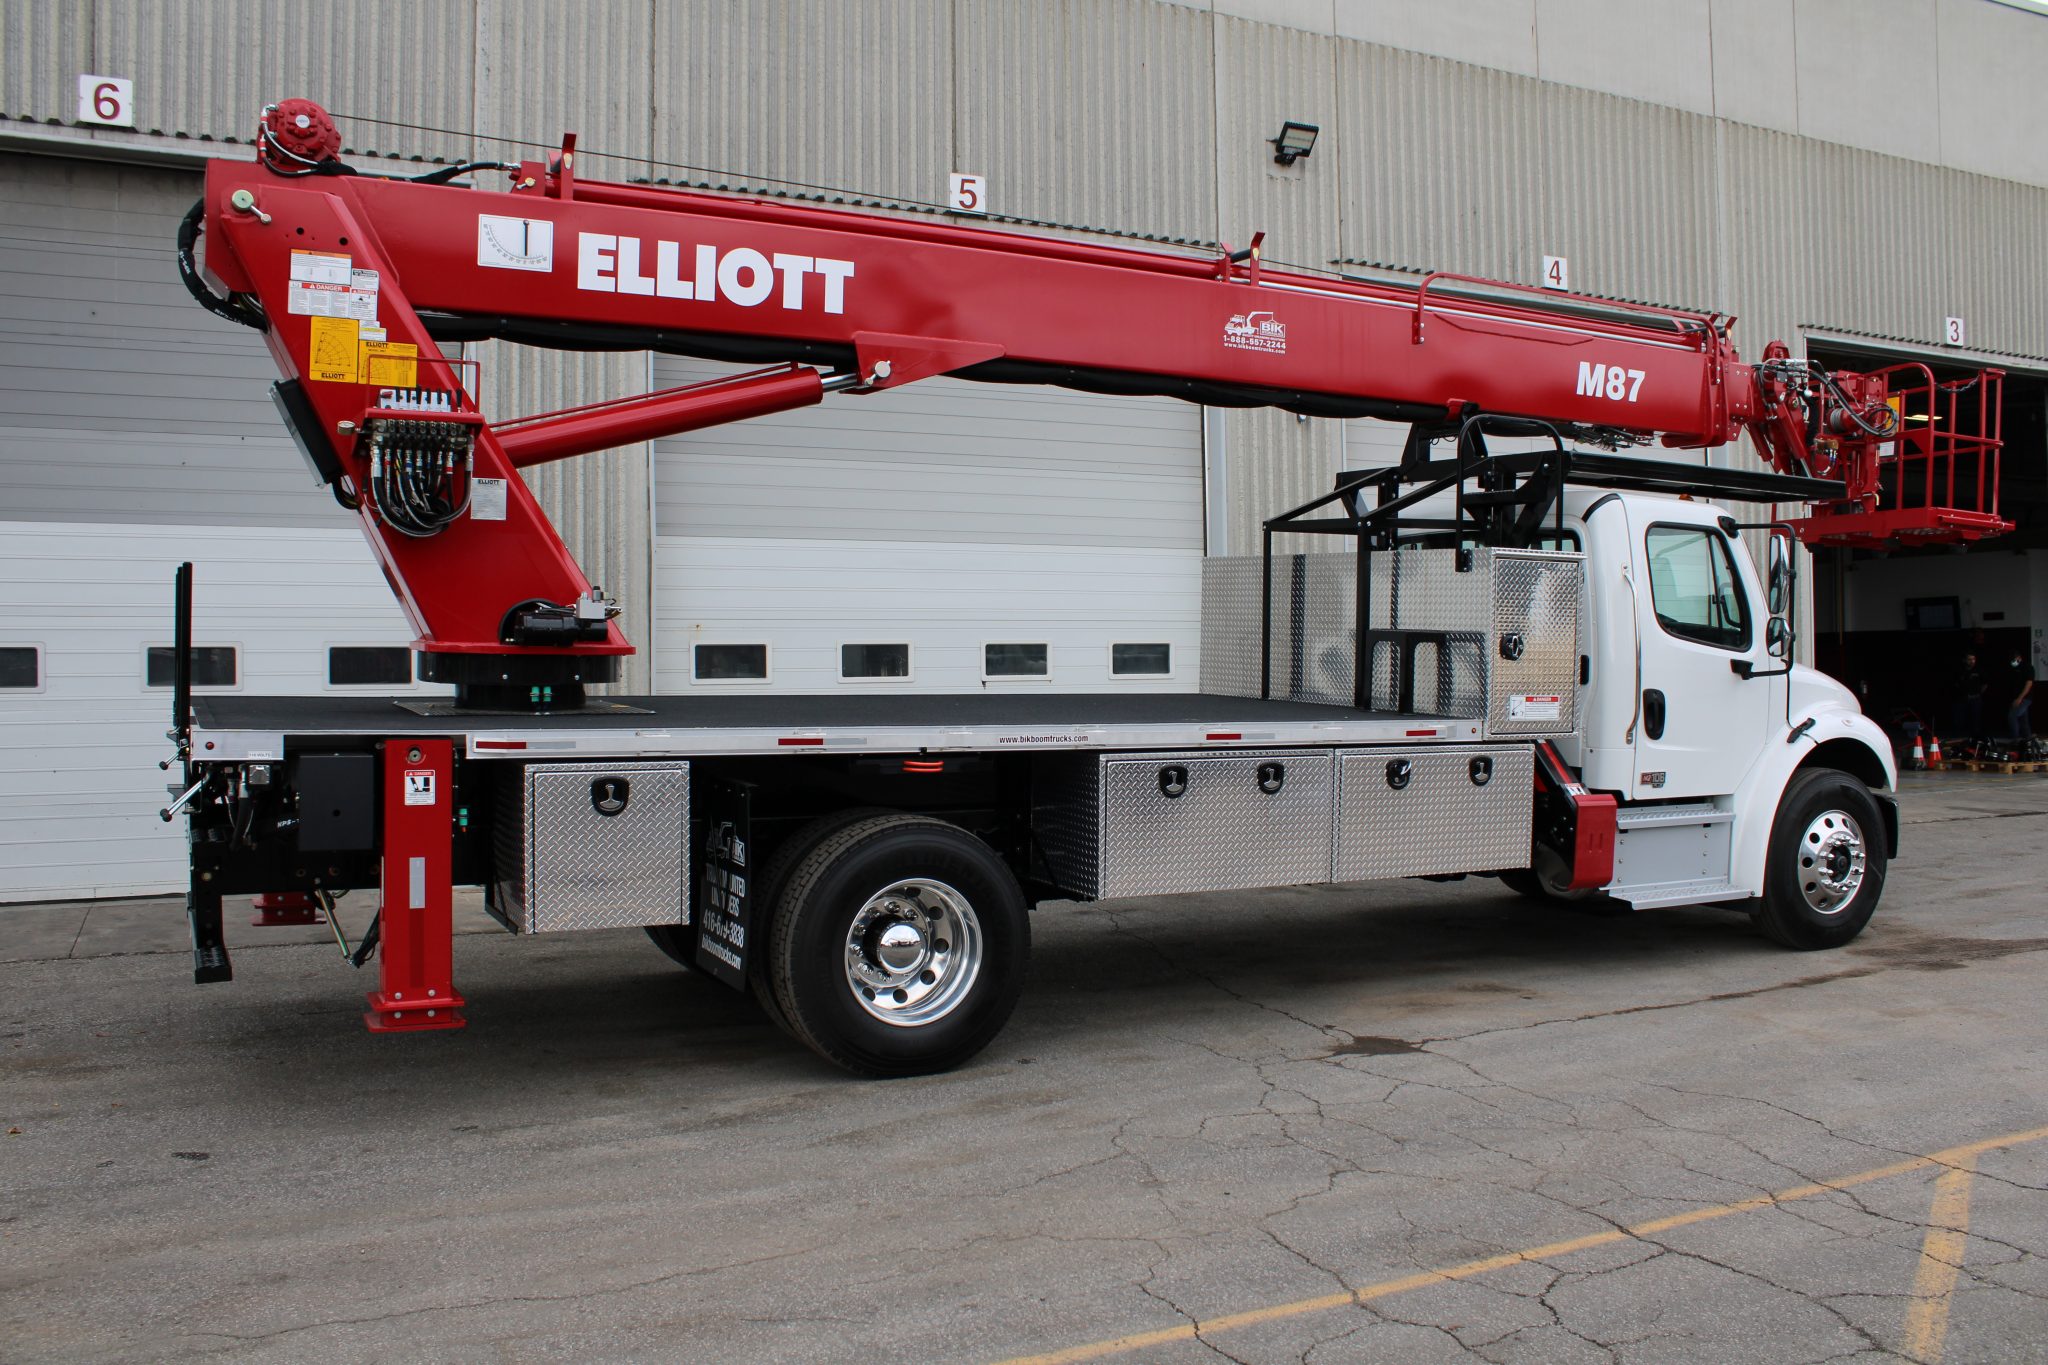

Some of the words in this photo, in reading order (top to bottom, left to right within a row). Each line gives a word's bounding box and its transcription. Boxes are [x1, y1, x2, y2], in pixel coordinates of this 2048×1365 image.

[94, 83, 120, 120] 6
[959, 178, 977, 209] 5
[577, 231, 855, 314] ELLIOTT
[1549, 260, 1562, 286] 4
[1261, 322, 1284, 334] BIK
[1950, 320, 1960, 343] 3
[366, 341, 388, 349] ELLIOTT
[1223, 334, 1285, 349] 1-888-557-2244
[1576, 361, 1646, 402] M87
[1000, 735, 1088, 743] www.bikboomtrucks.com
